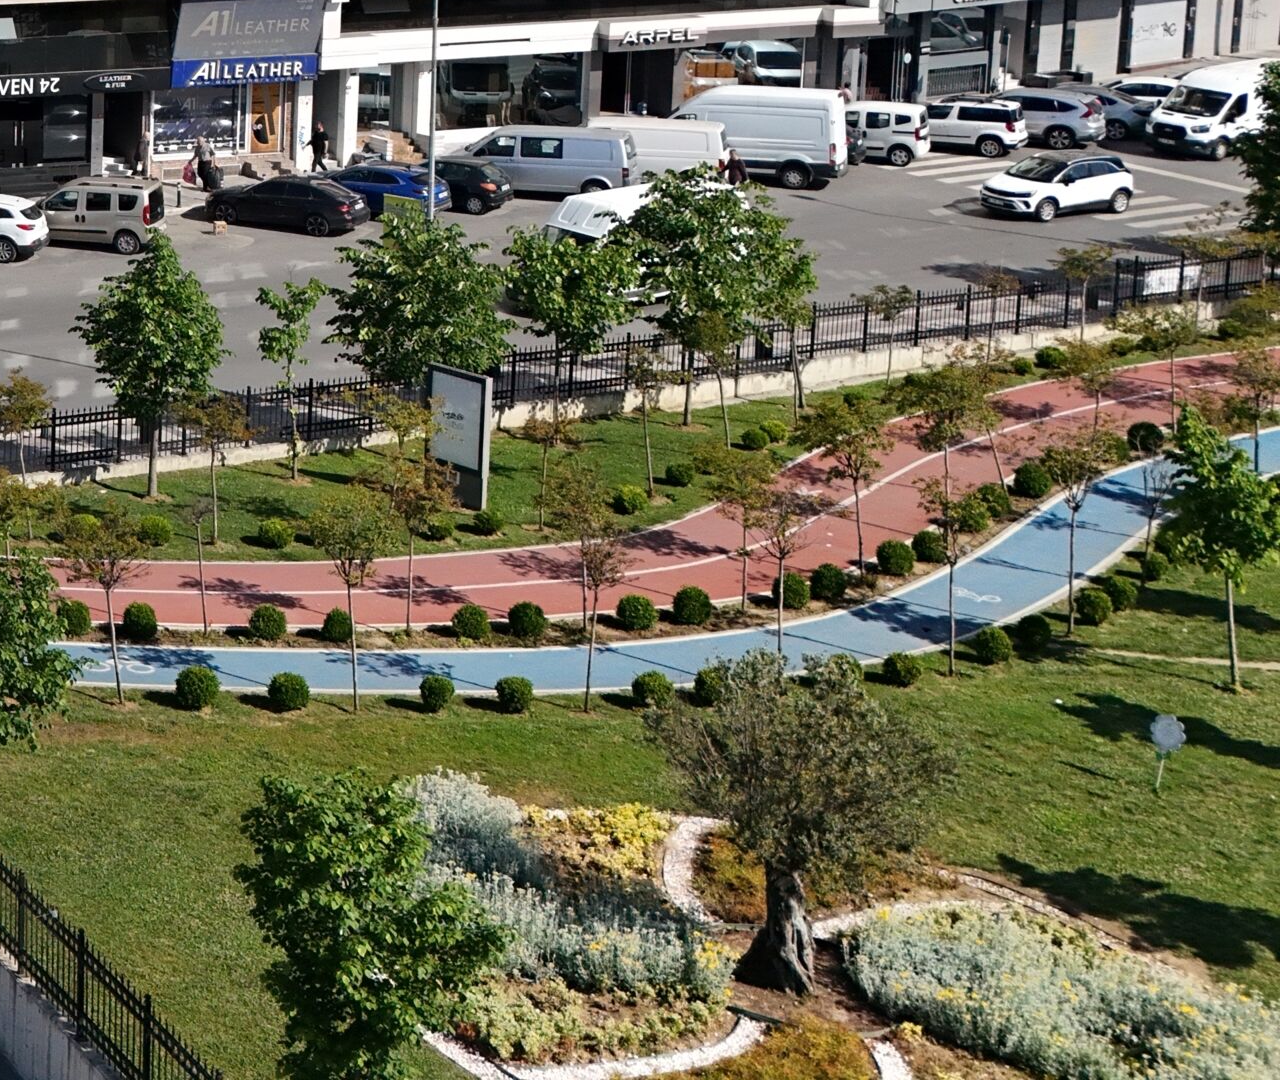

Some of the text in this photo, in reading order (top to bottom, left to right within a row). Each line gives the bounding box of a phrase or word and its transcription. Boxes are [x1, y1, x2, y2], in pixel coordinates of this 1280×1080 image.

[192, 10, 310, 38] A1 LEATHER
[622, 27, 699, 44] ARPEL
[192, 61, 303, 81] A1 LEATHER
